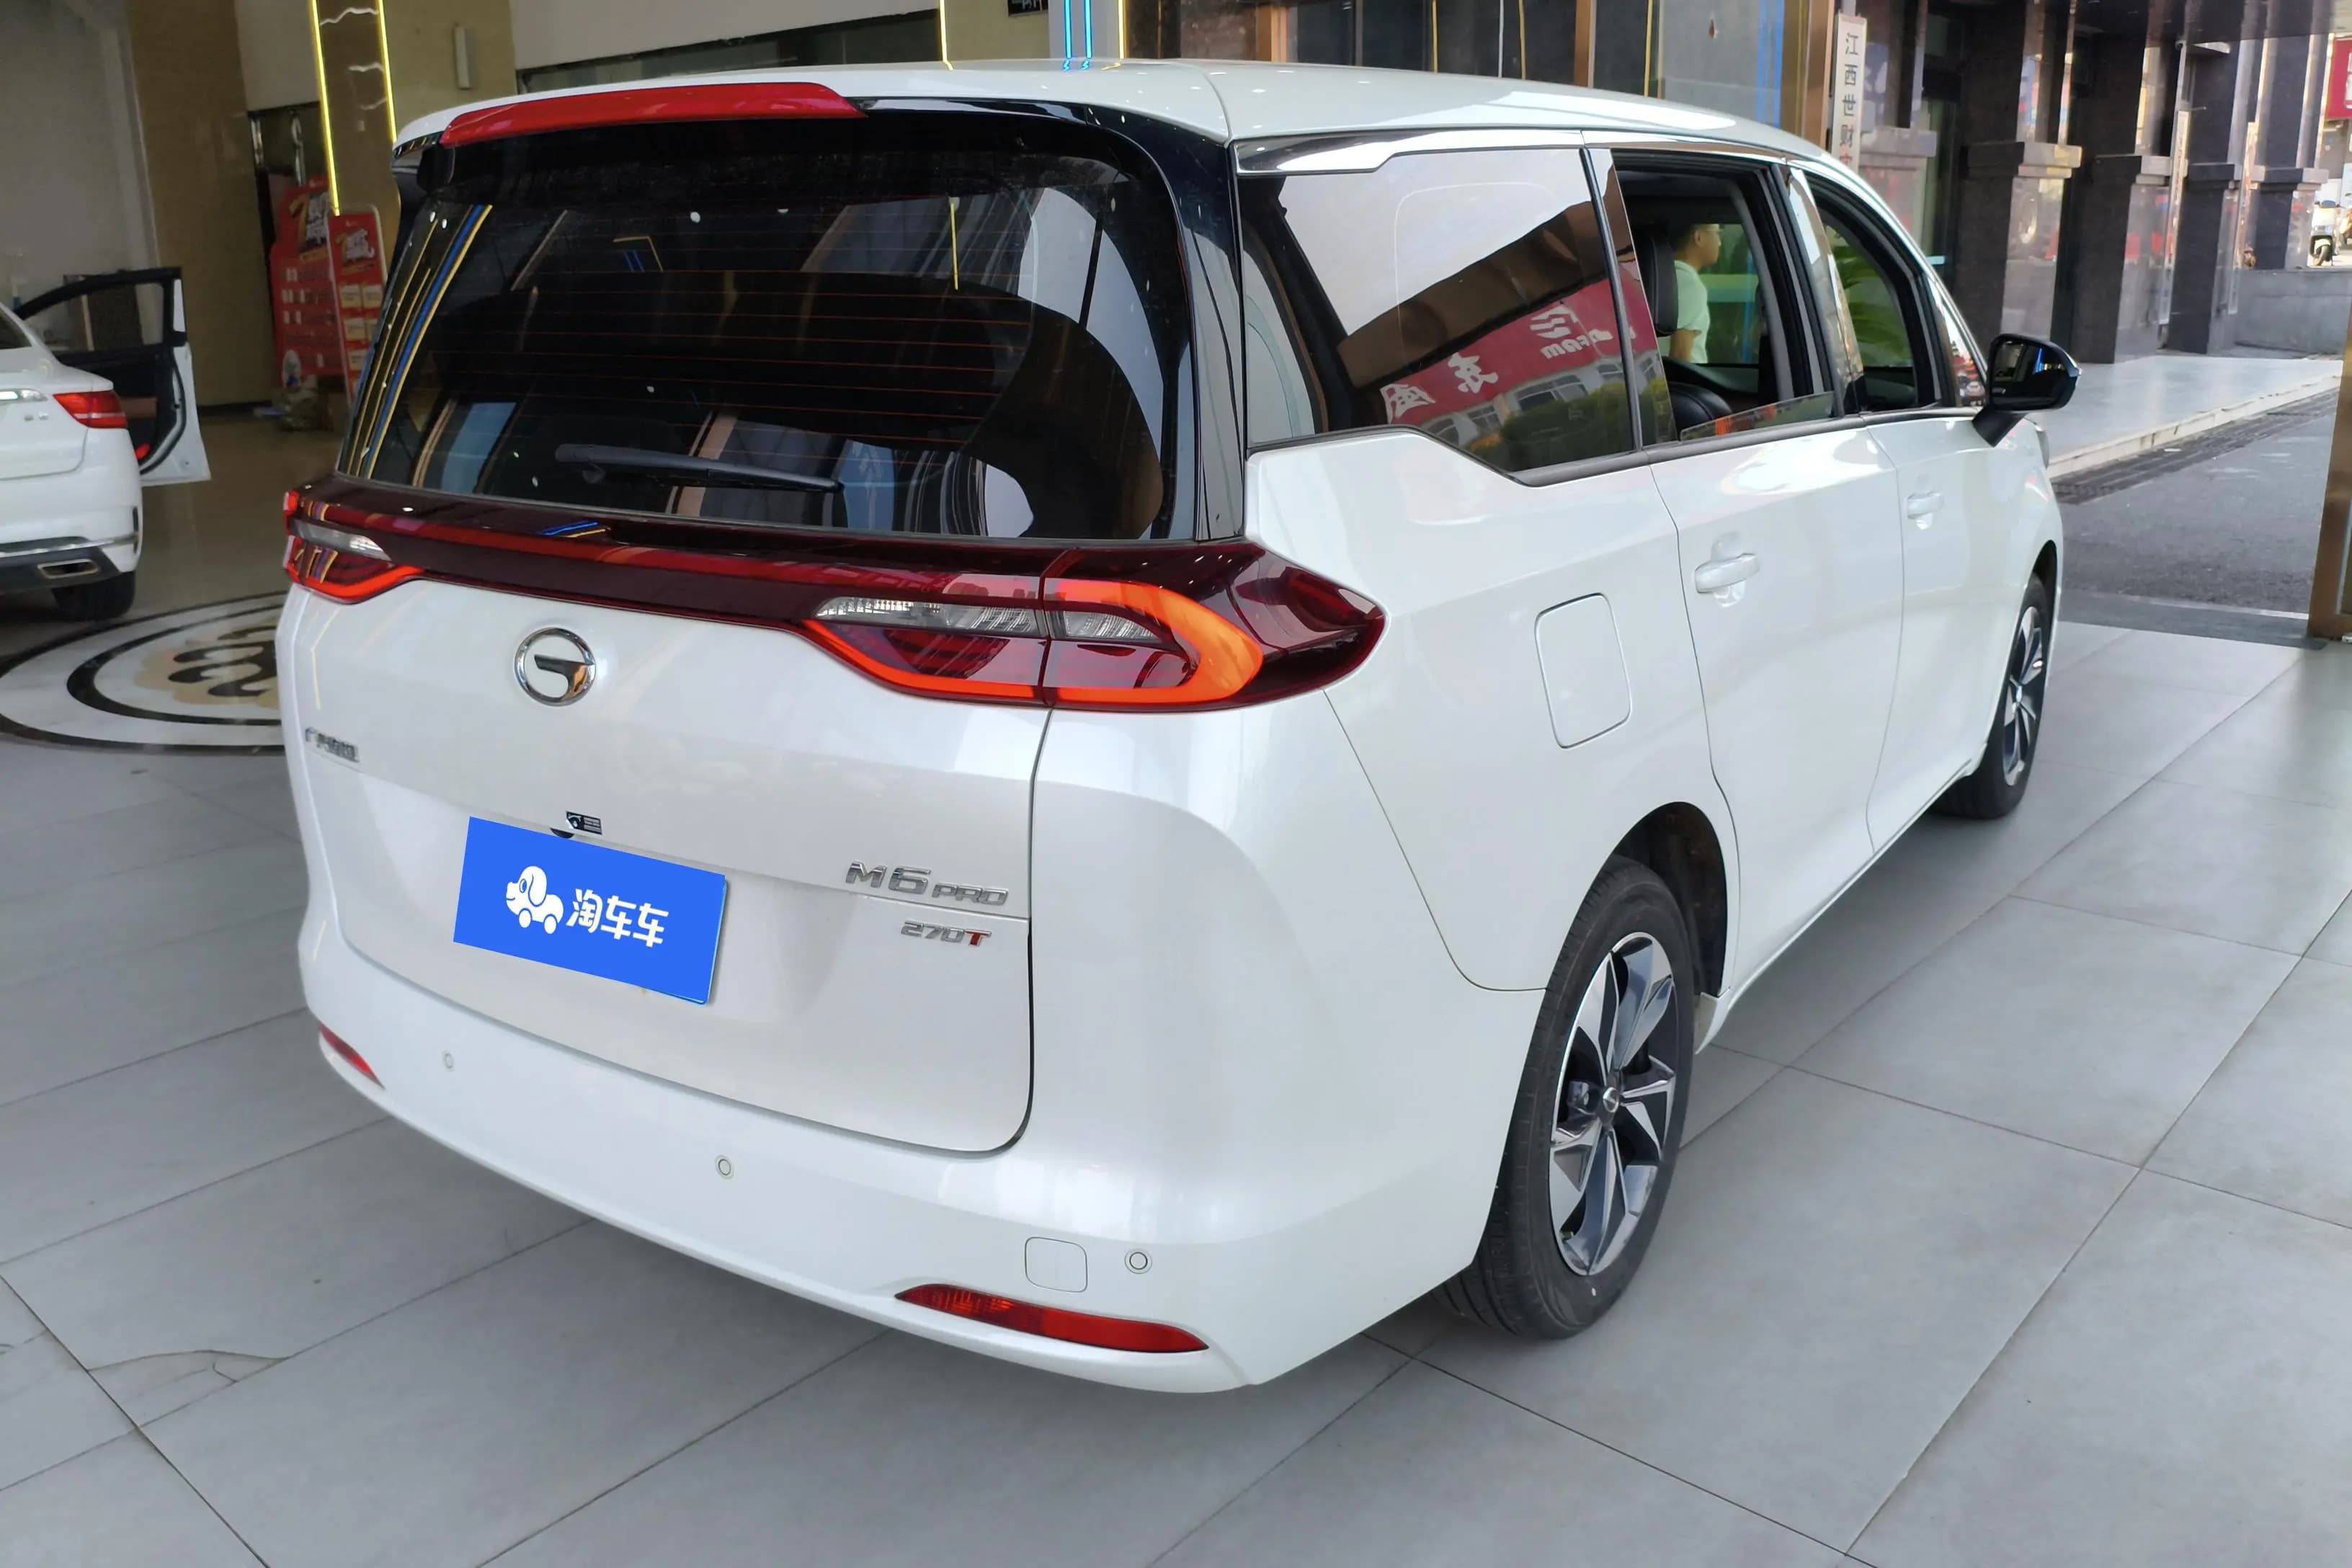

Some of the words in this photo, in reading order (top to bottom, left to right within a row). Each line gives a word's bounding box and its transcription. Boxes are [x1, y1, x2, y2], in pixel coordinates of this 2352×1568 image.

[846, 861, 931, 895] M6
[932, 881, 1009, 906] PRO
[901, 919, 992, 947] 270T
